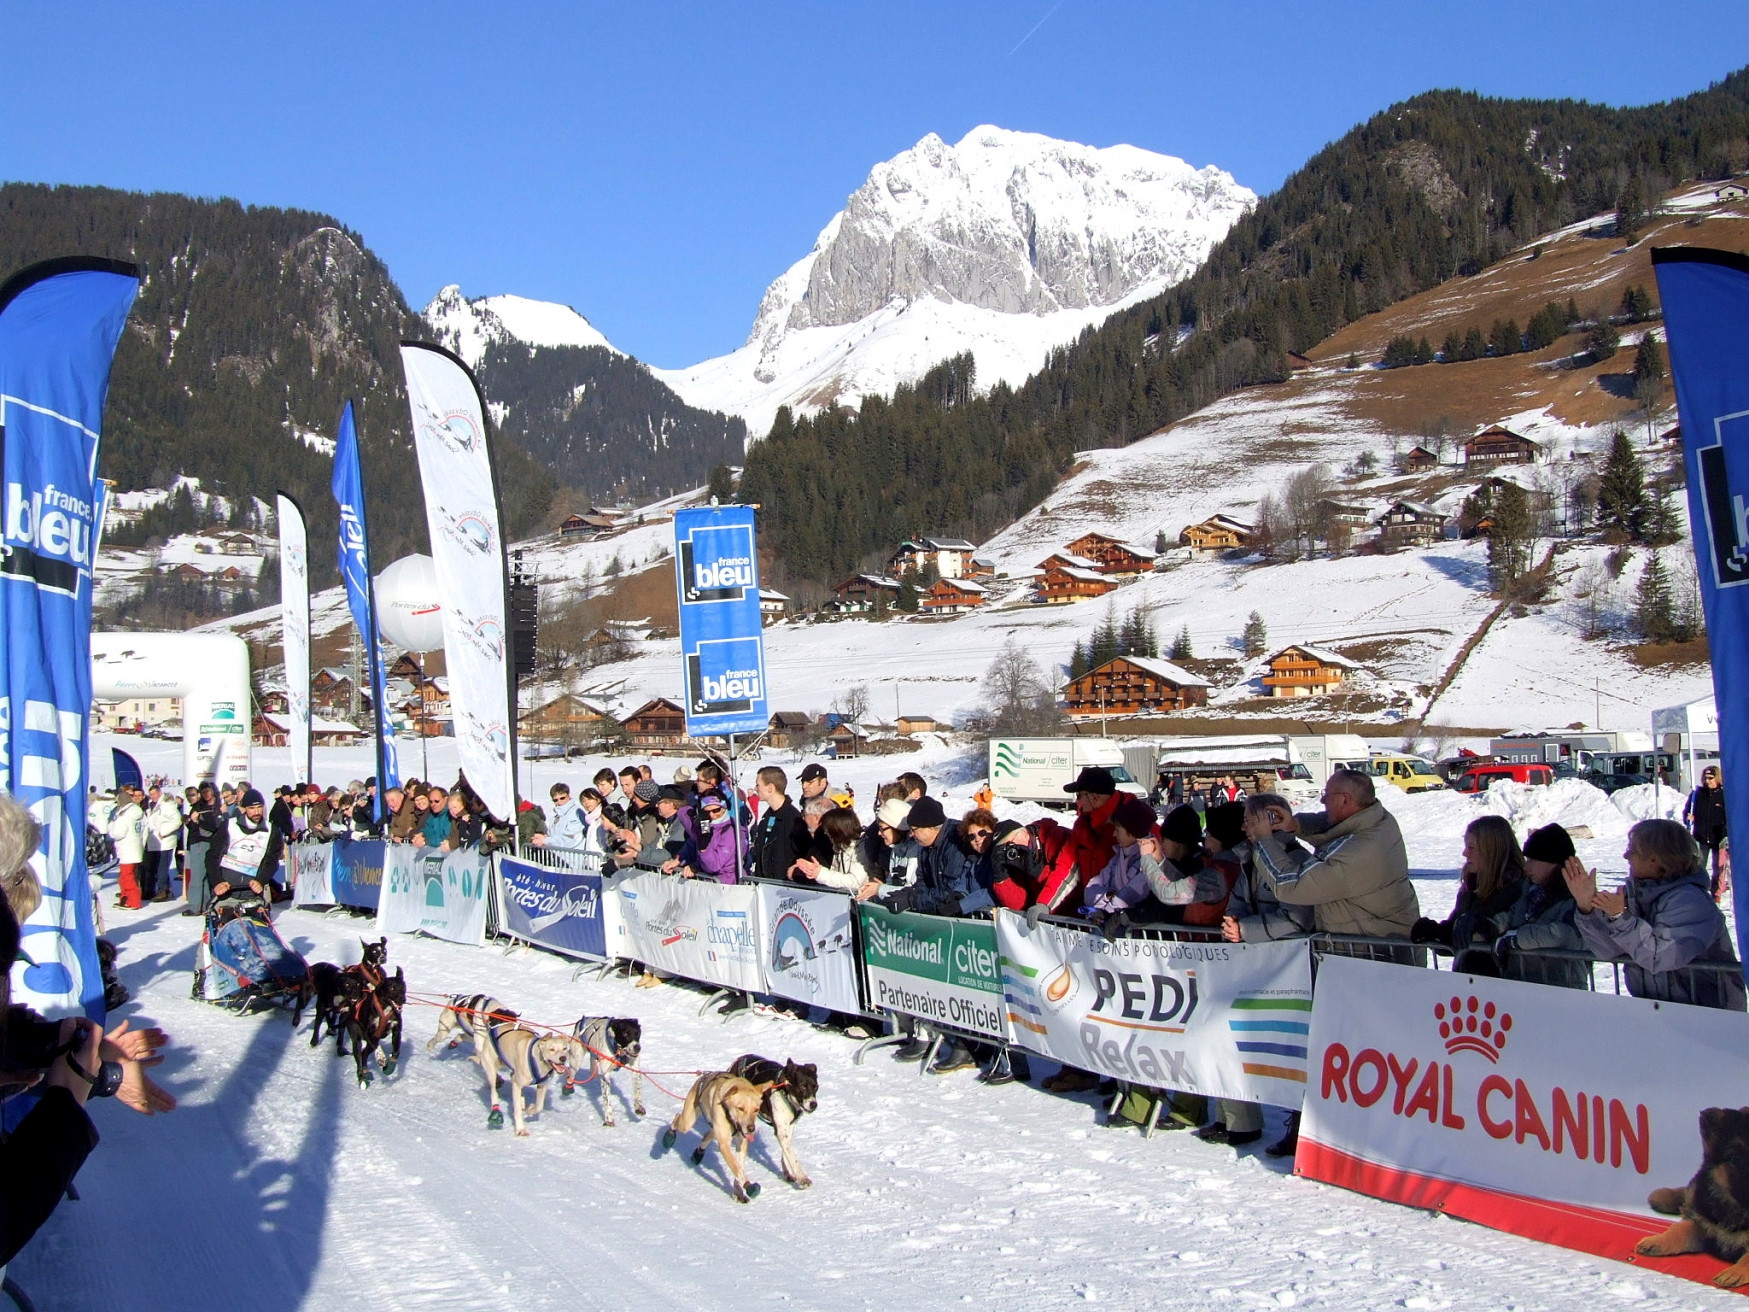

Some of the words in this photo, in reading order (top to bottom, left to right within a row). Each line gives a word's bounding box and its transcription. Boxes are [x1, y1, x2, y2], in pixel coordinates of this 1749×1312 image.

[44, 484, 91, 521] france
[7, 482, 90, 566] bleu
[696, 563, 751, 589] bleu
[718, 556, 750, 567] france
[703, 674, 760, 701] bleu
[726, 669, 757, 680] france
[1022, 756, 1046, 765] National
[1051, 756, 1068, 765] citer
[504, 878, 545, 908] Portes
[538, 890, 561, 913] du
[645, 920, 662, 935] Portes
[707, 920, 756, 952] chapelle
[887, 928, 942, 965] National
[955, 939, 999, 979] citer
[1134, 943, 1229, 963] PODOLOGIQUES
[879, 979, 946, 1018] Partenaire
[949, 996, 1003, 1033] Officiel
[1080, 1022, 1195, 1084] Relax
[1321, 1042, 1465, 1131] ROYAL
[1477, 1074, 1649, 1175] CANIN
